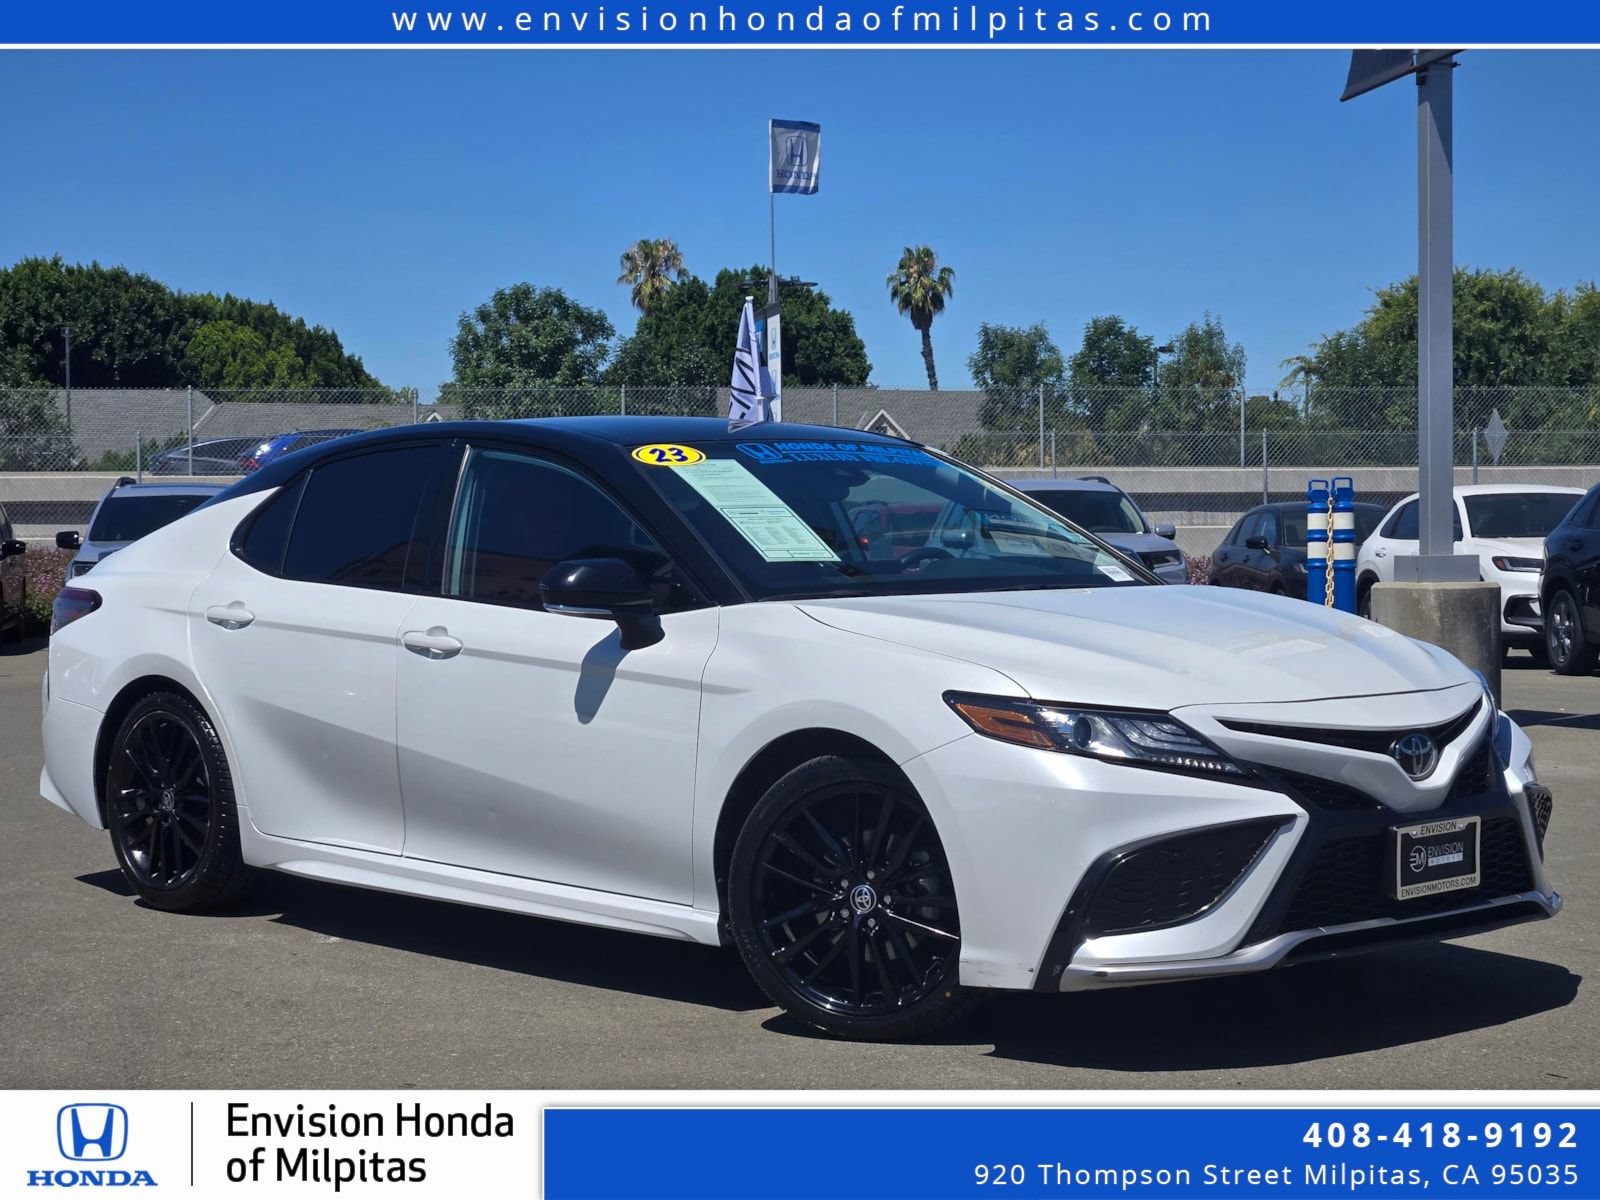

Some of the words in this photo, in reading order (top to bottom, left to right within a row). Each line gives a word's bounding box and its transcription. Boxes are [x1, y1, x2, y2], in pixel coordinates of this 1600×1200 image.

[649, 447, 689, 463] 23
[1420, 821, 1457, 835] ENVISION
[1427, 842, 1464, 858] ENVISION
[1401, 876, 1477, 898] ENVISIONMOTORS.COM
